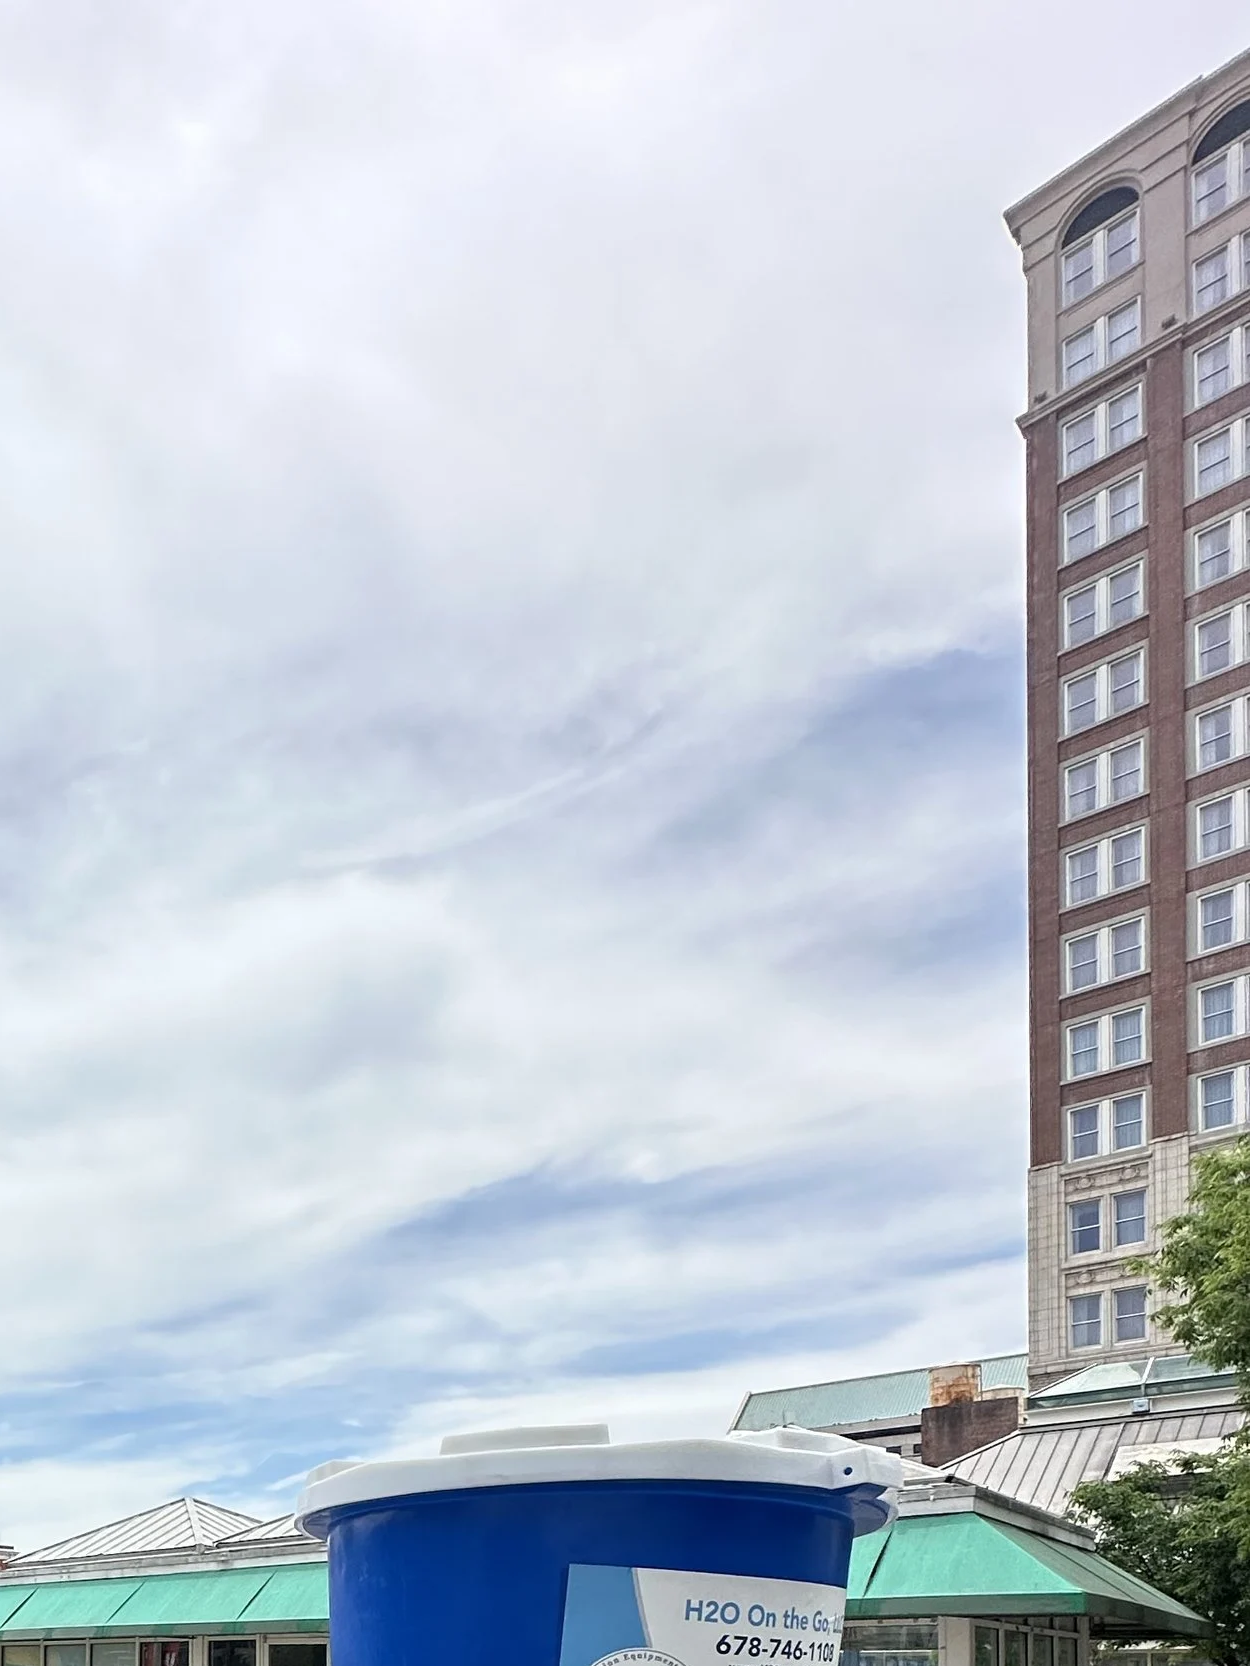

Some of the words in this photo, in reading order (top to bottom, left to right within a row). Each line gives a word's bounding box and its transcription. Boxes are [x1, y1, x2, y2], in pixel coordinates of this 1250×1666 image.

[684, 1599, 740, 1625] H2O
[748, 1604, 777, 1627] On
[783, 1606, 809, 1630] the
[716, 1634, 835, 1662] 678-746-1108
